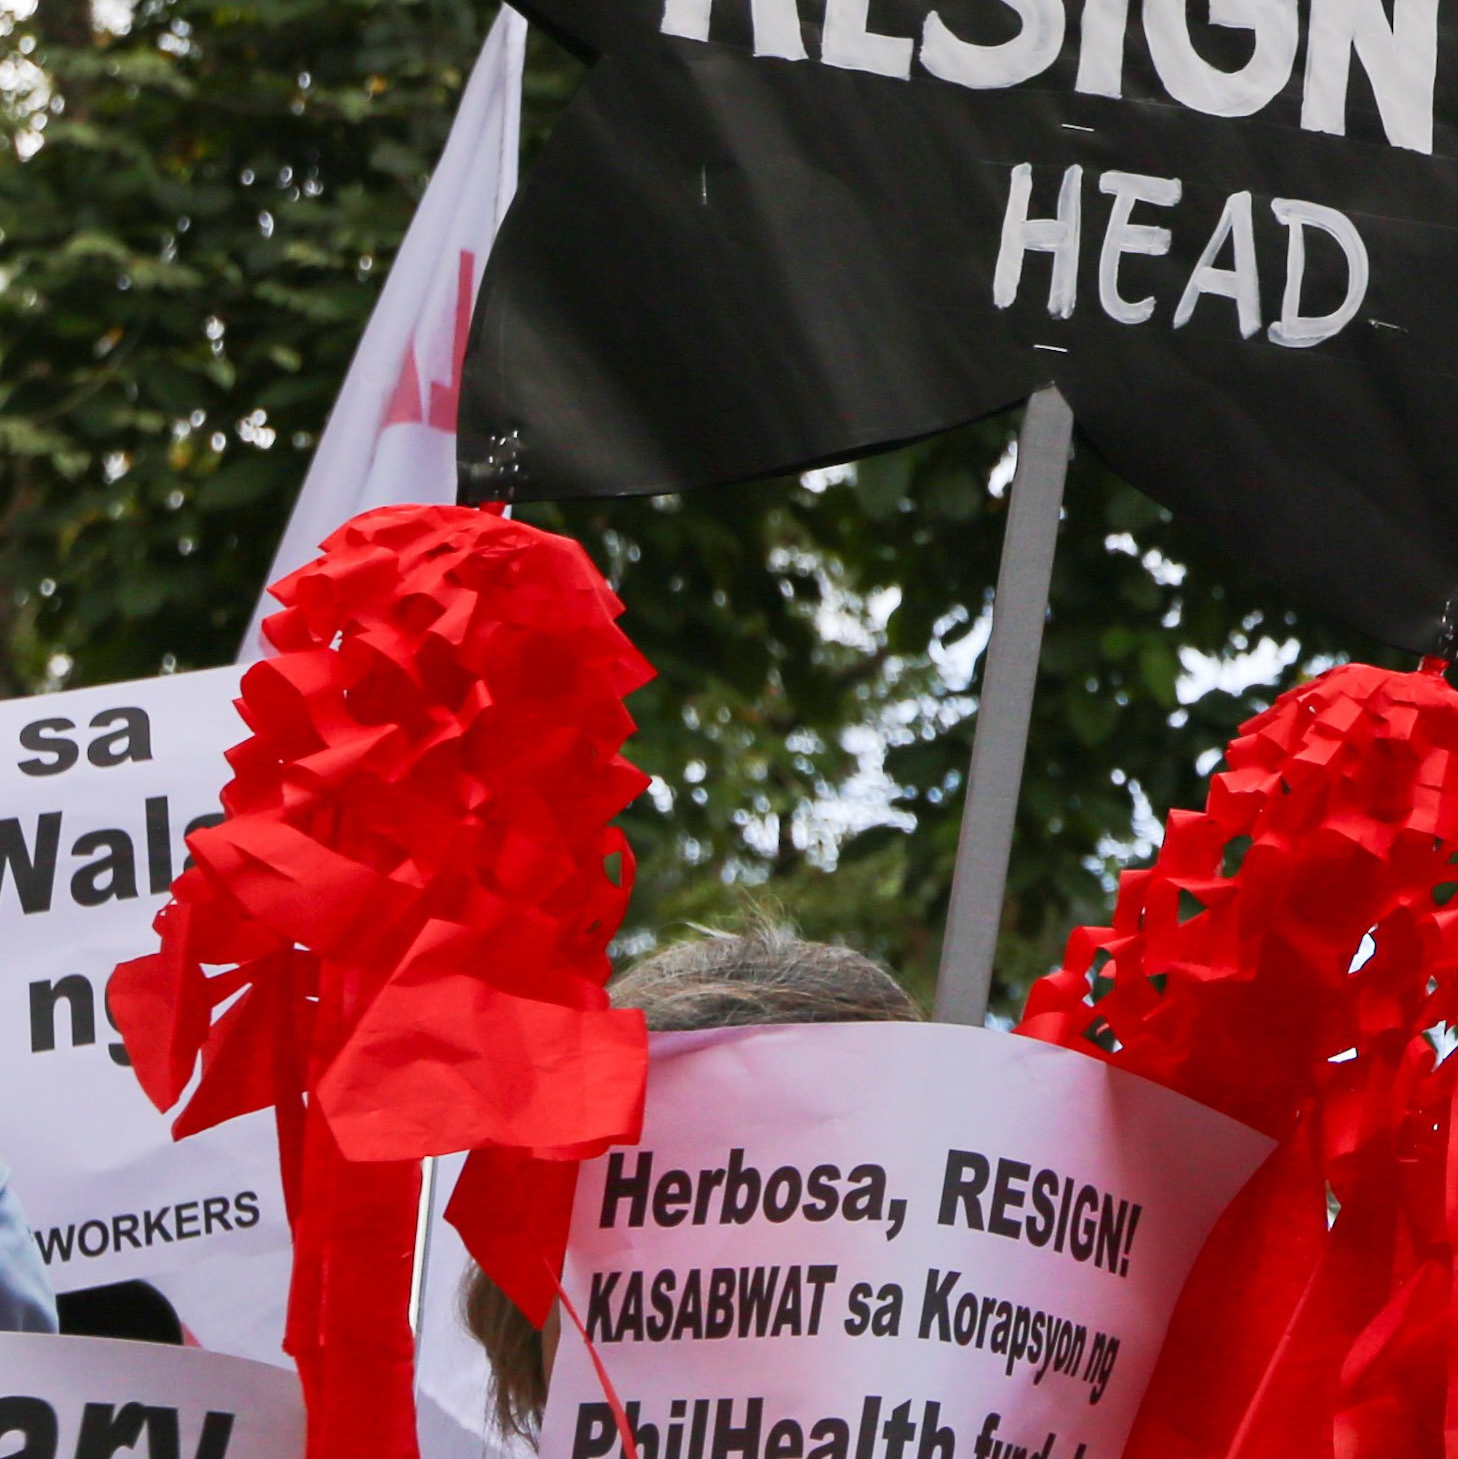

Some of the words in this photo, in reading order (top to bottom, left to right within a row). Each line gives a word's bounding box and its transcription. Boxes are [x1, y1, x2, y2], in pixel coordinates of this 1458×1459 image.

[993, 162, 1370, 348] HEAD
[17, 706, 154, 777] sa
[0, 795, 226, 915] Wal
[34, 1190, 260, 1265] WORKERS
[599, 1148, 908, 1242] Herbosa,
[937, 1149, 1142, 1278] RESIGN!
[584, 1264, 837, 1345] KASABWAT
[844, 1281, 904, 1337] sa
[918, 1268, 1088, 1386] Korapsyon
[1084, 1335, 1121, 1406] ng
